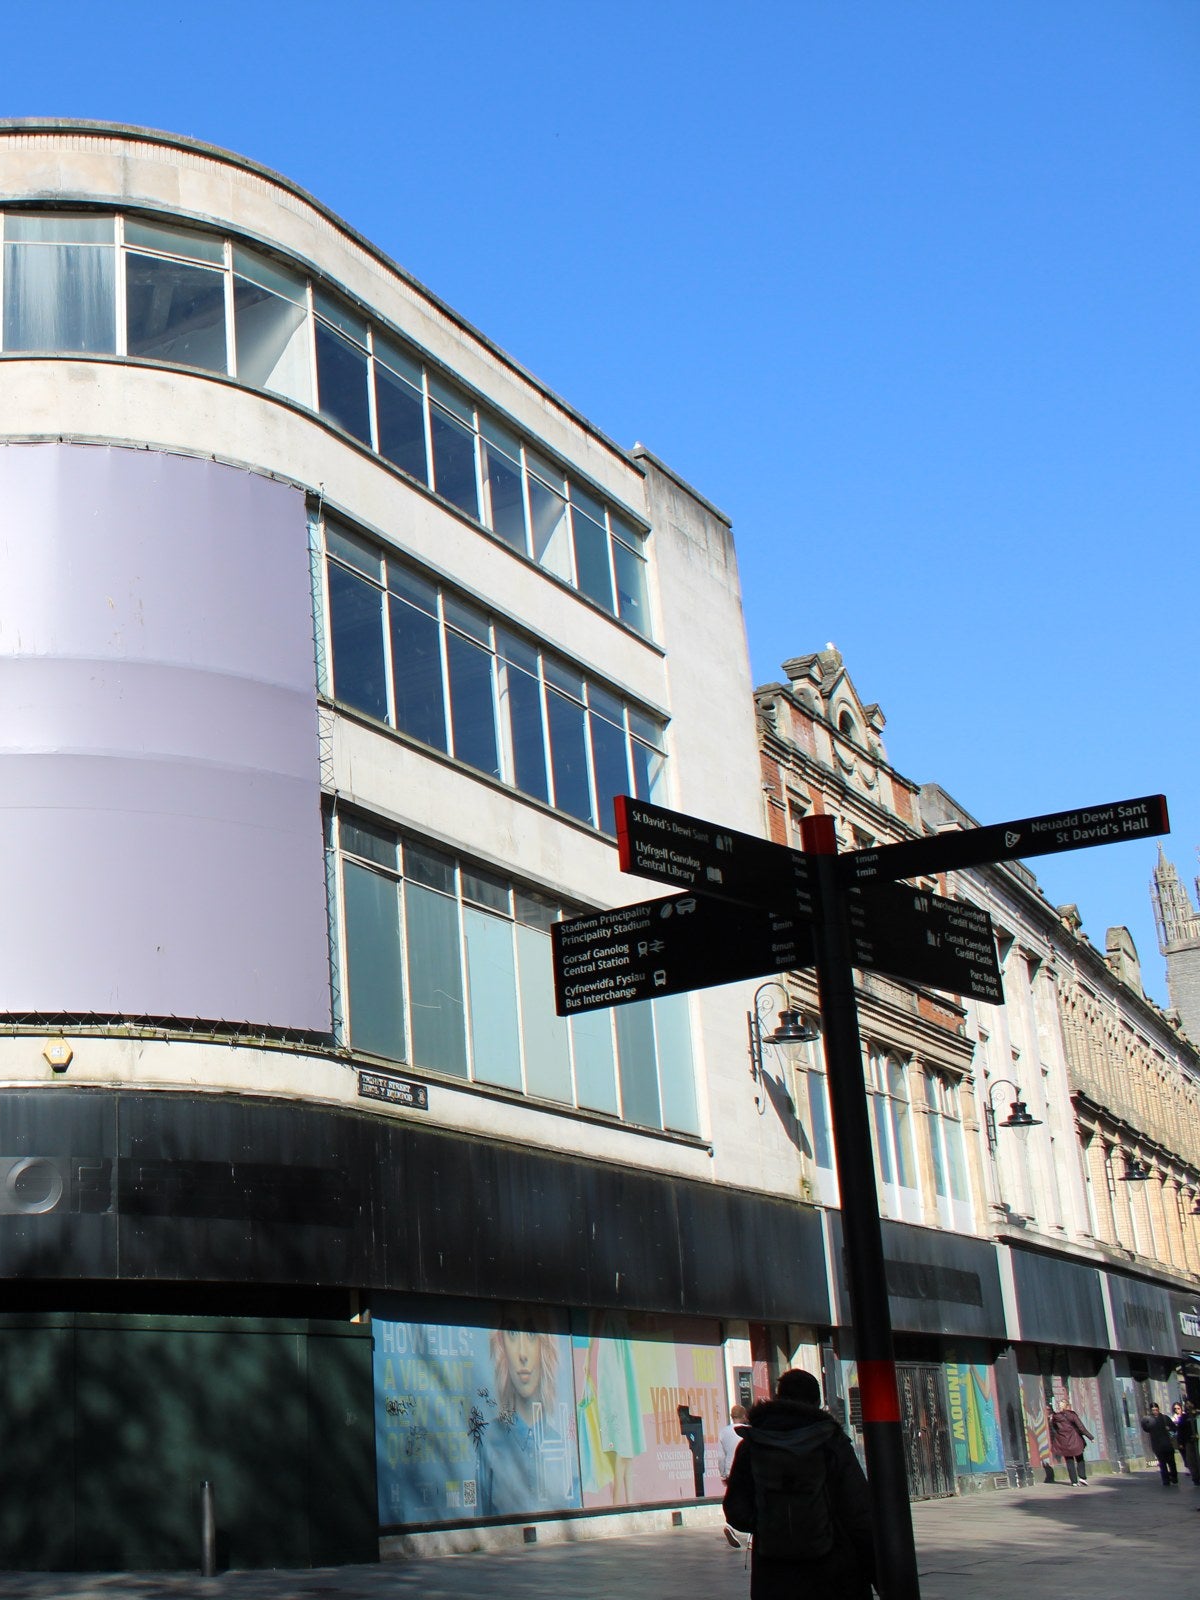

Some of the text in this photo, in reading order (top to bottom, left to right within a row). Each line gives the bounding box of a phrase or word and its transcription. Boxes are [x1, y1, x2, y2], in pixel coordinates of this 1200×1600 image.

[632, 810, 709, 844] St David's Dewi Sant
[1031, 803, 1148, 833] Neuadd Dewi Sant
[1056, 817, 1149, 844] St David's Hall
[635, 840, 701, 871] Llyfrgell Ganolog
[855, 853, 879, 864] 1mun
[637, 856, 695, 883] Central Library
[856, 867, 877, 877] 1min
[561, 905, 652, 934] Stadiwm Principality
[948, 914, 988, 935] Cardiff Market
[562, 920, 651, 946] Principality Stadium
[944, 932, 965, 946] Castell
[563, 943, 629, 965] Gorsaf Ganolog
[563, 955, 630, 977] Central Station
[955, 947, 993, 966] Cardiff Castle
[564, 972, 646, 997] Cyfnewidfa Fysiau
[970, 969, 997, 985] Parc Bute
[971, 981, 999, 997] Bute Park
[565, 987, 637, 1008] Bus Interchange
[382, 1321, 474, 1357] HOWELLS:
[383, 1358, 474, 1392] A VIBRANT
[385, 1395, 429, 1428] NEW
[386, 1431, 473, 1470] QUARTER
